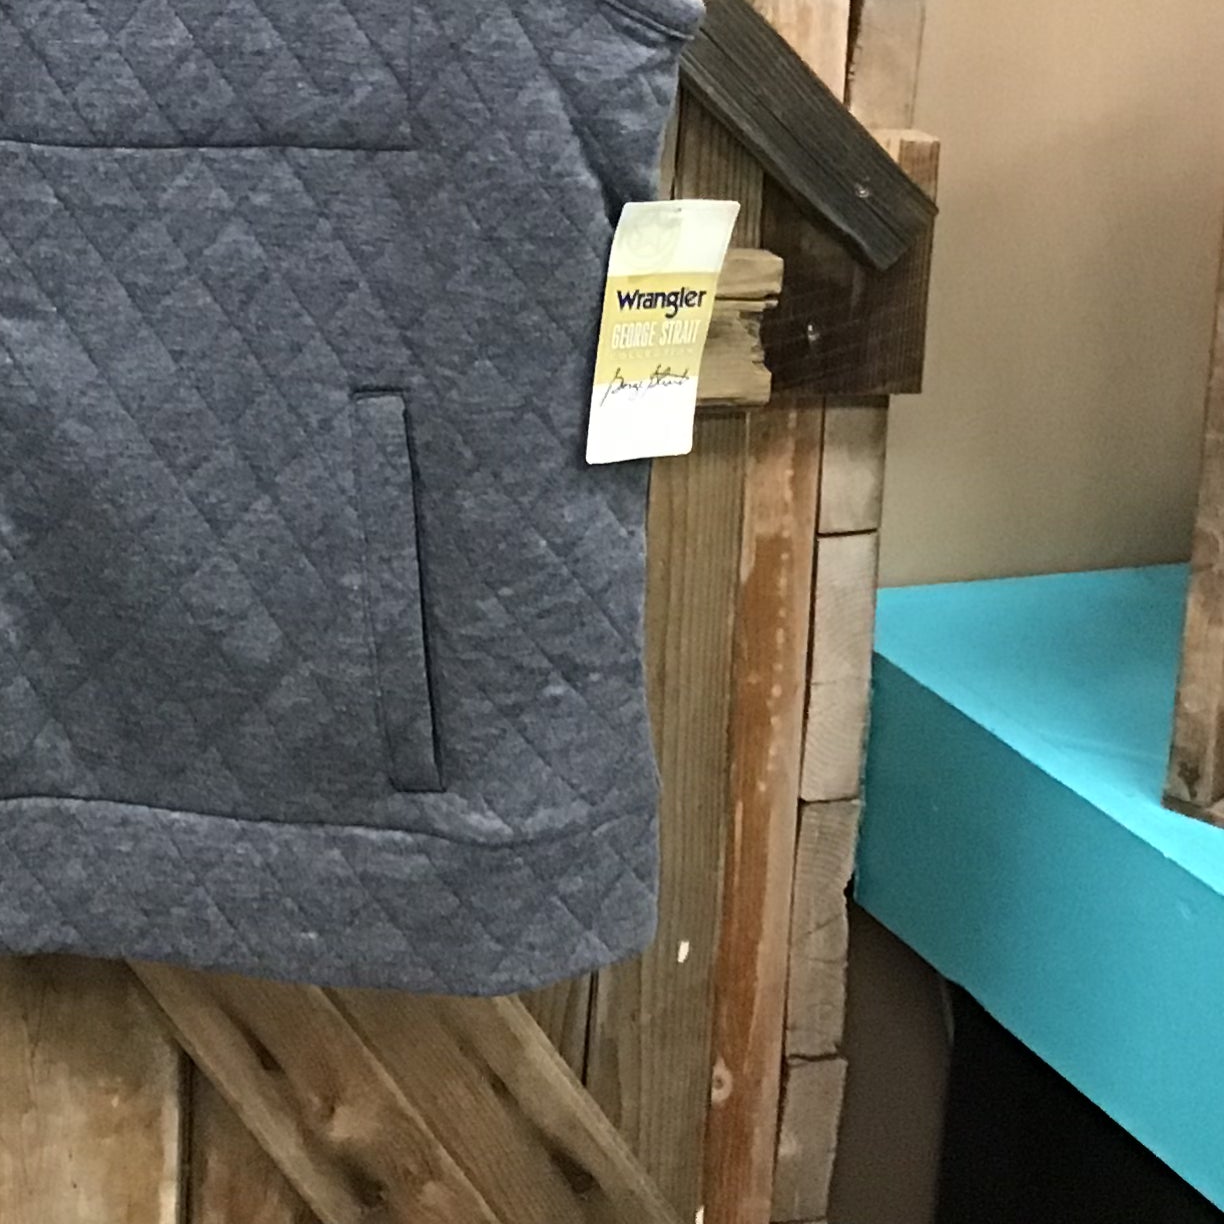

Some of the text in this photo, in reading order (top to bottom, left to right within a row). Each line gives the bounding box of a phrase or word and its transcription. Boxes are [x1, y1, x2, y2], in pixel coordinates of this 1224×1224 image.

[617, 287, 707, 318] Wrangler
[612, 319, 701, 349] GEORGE STRAIT
